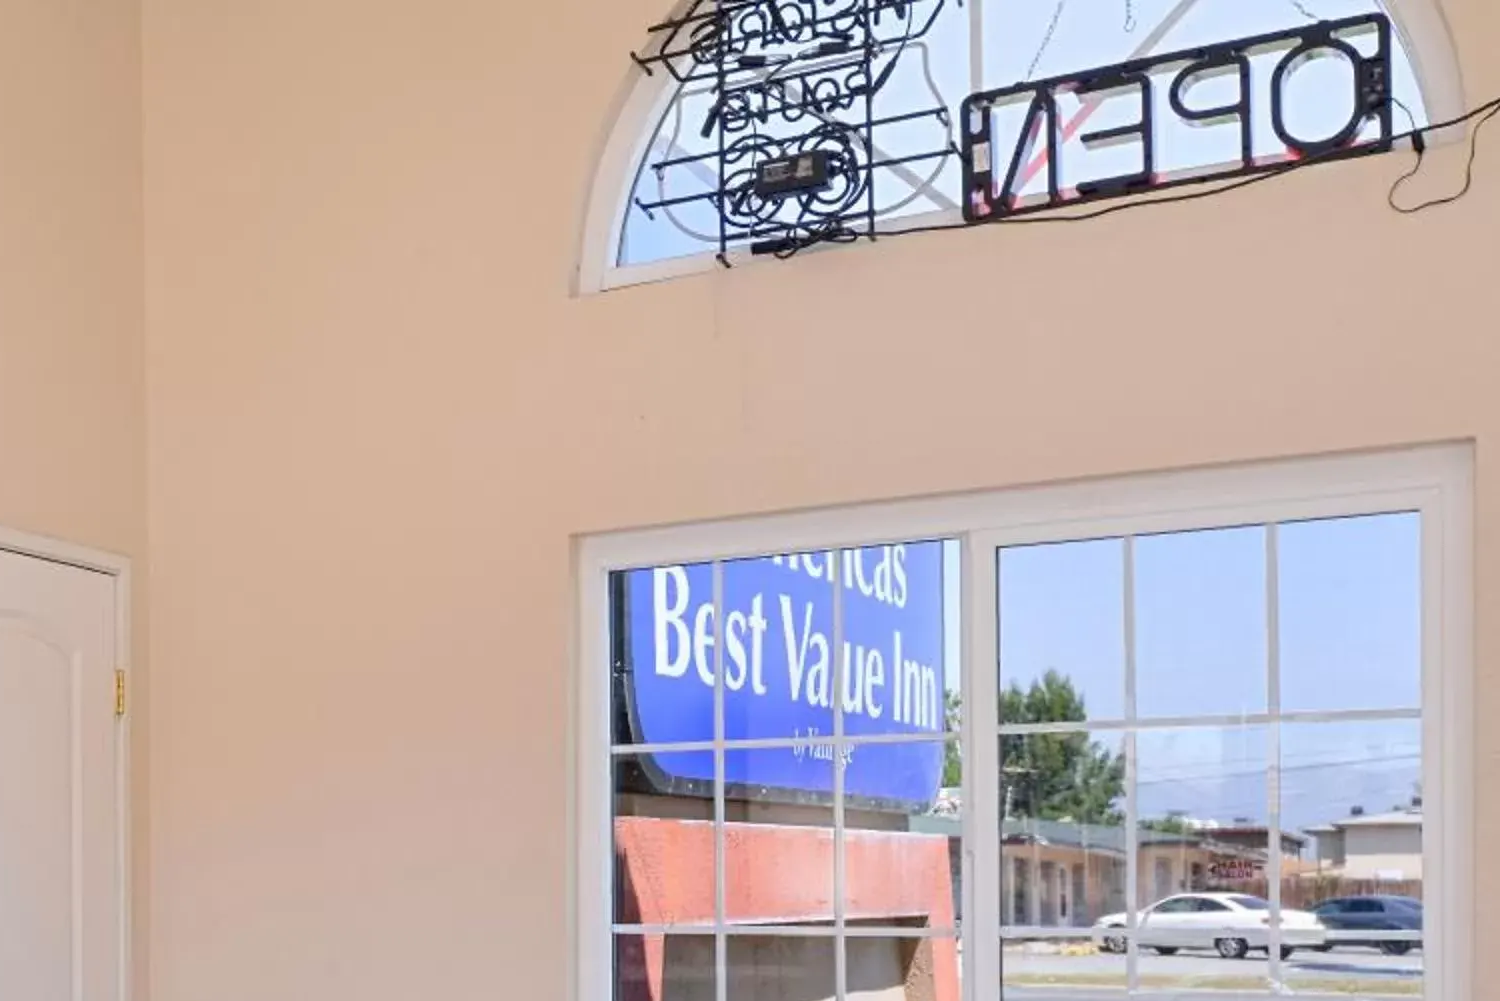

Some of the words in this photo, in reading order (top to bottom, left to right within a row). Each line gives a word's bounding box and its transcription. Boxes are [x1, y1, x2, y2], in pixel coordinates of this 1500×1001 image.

[652, 565, 768, 696] Best
[778, 593, 885, 719] Vaue
[892, 629, 938, 731] Inn
